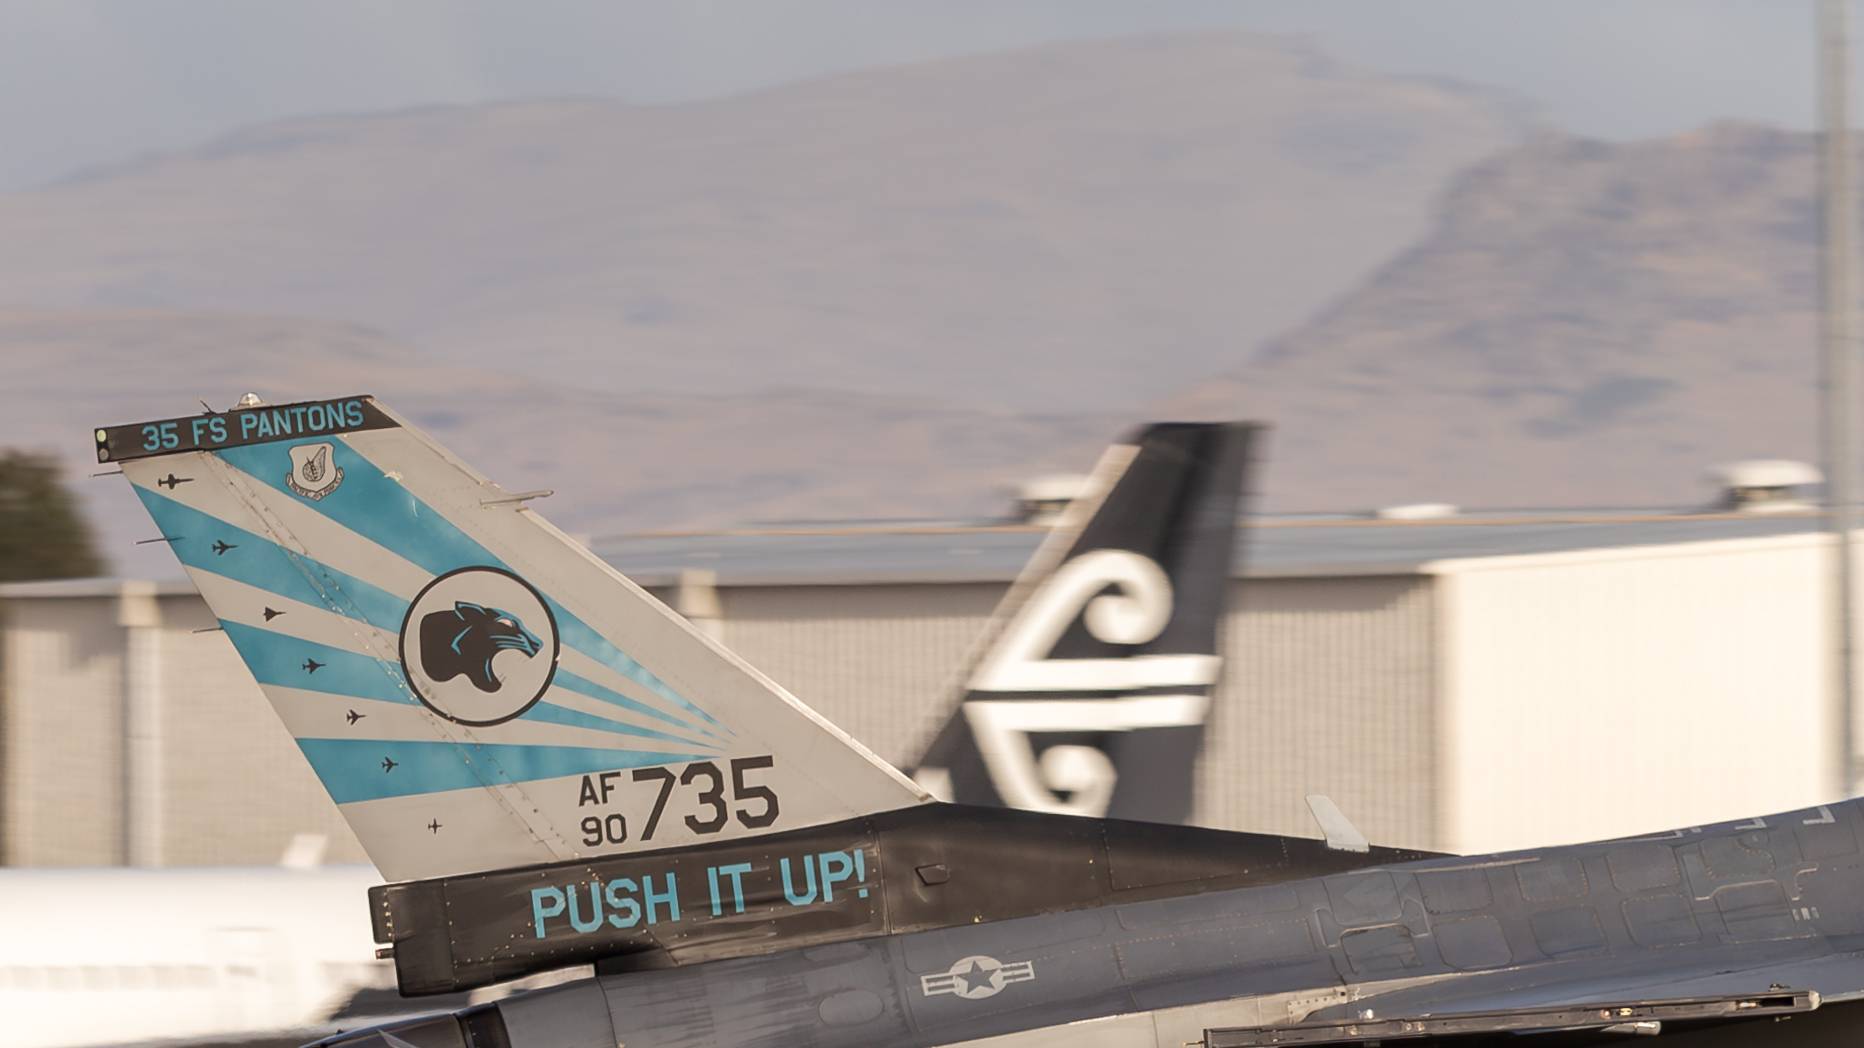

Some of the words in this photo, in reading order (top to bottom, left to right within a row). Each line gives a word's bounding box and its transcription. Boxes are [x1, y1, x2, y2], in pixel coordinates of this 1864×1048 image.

[142, 423, 179, 451] 35
[192, 417, 228, 446] FS
[241, 401, 364, 440] PANTONS
[579, 771, 621, 807] AF
[632, 755, 780, 841] 735
[581, 813, 627, 847] 90
[531, 872, 681, 939] PUSH
[707, 862, 752, 916] IT
[780, 849, 868, 905] UP!
